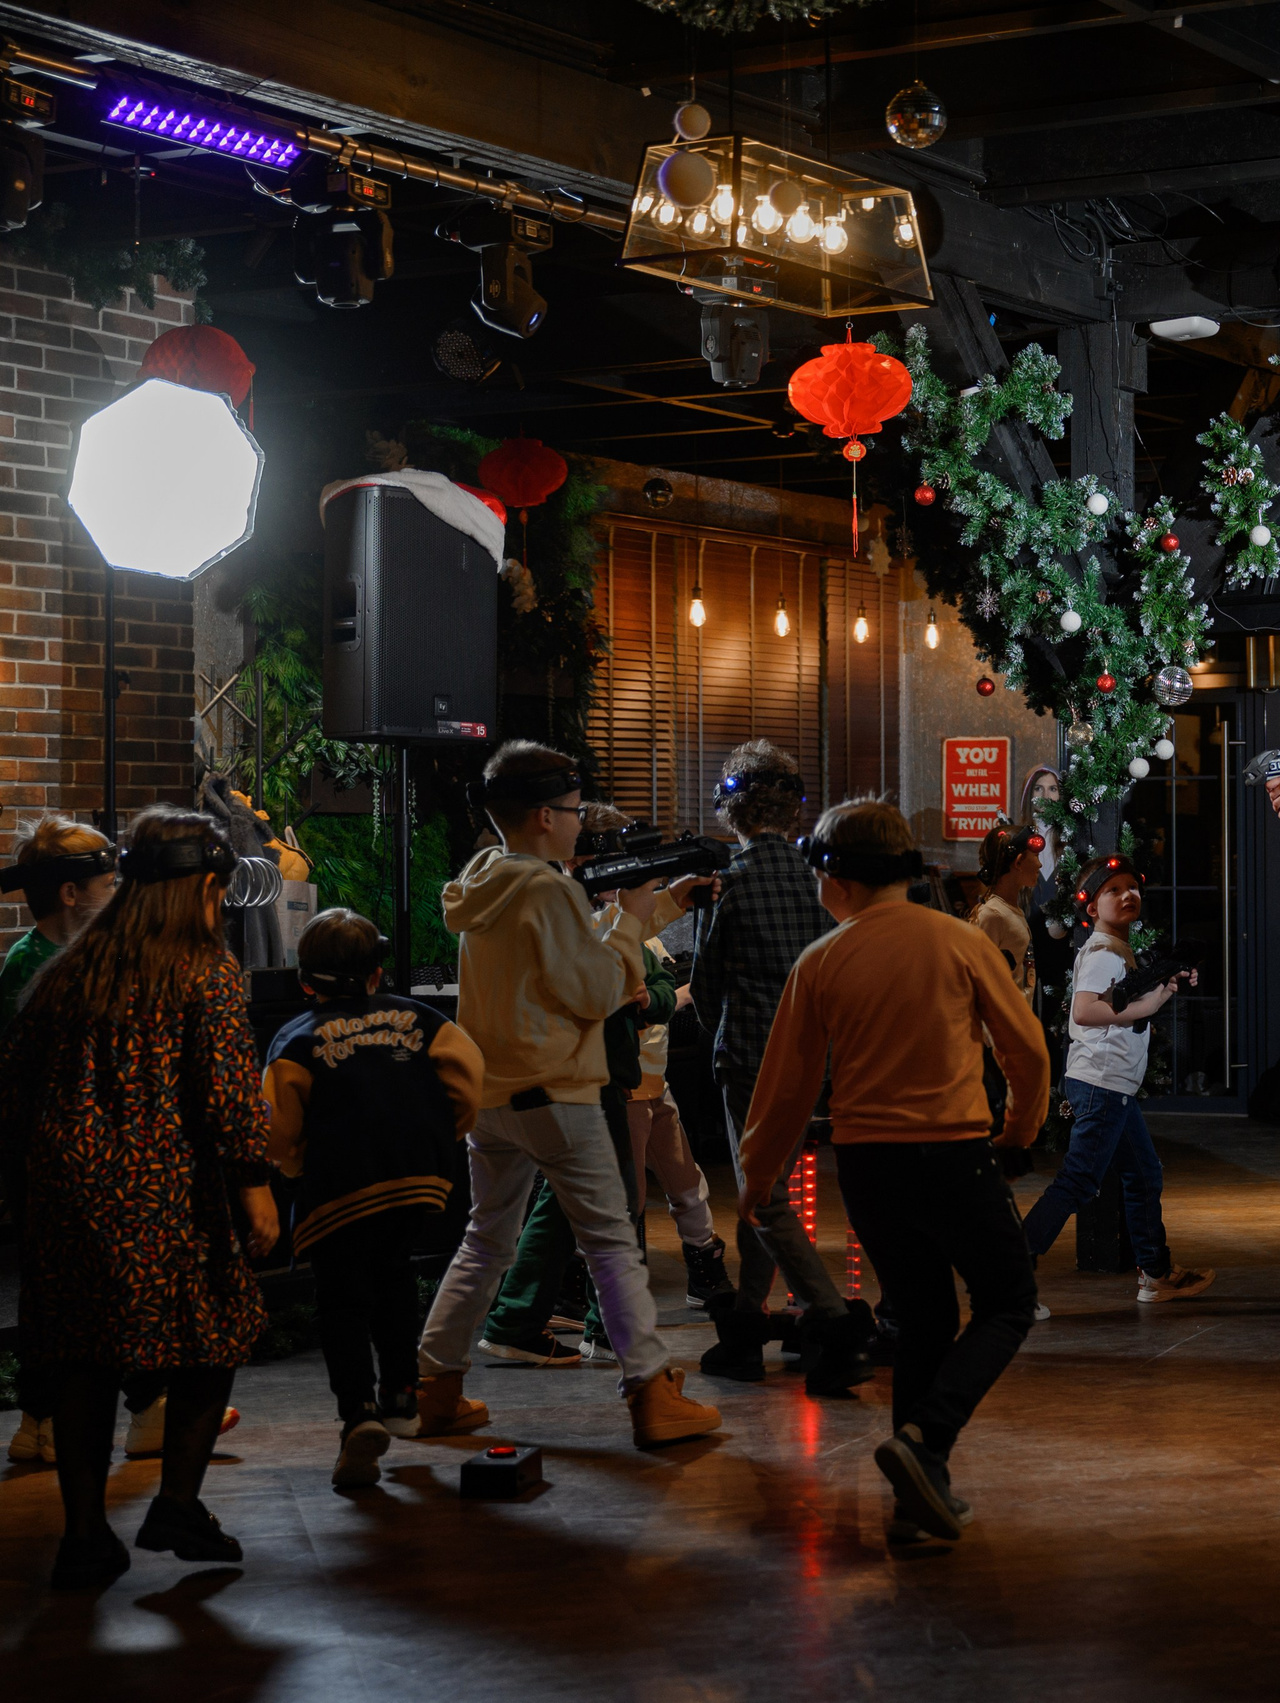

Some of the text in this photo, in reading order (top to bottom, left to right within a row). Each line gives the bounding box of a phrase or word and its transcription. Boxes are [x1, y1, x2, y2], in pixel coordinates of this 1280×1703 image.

[476, 725, 485, 736] 15
[956, 747, 999, 764] YOU
[951, 783, 1000, 797] WHEN
